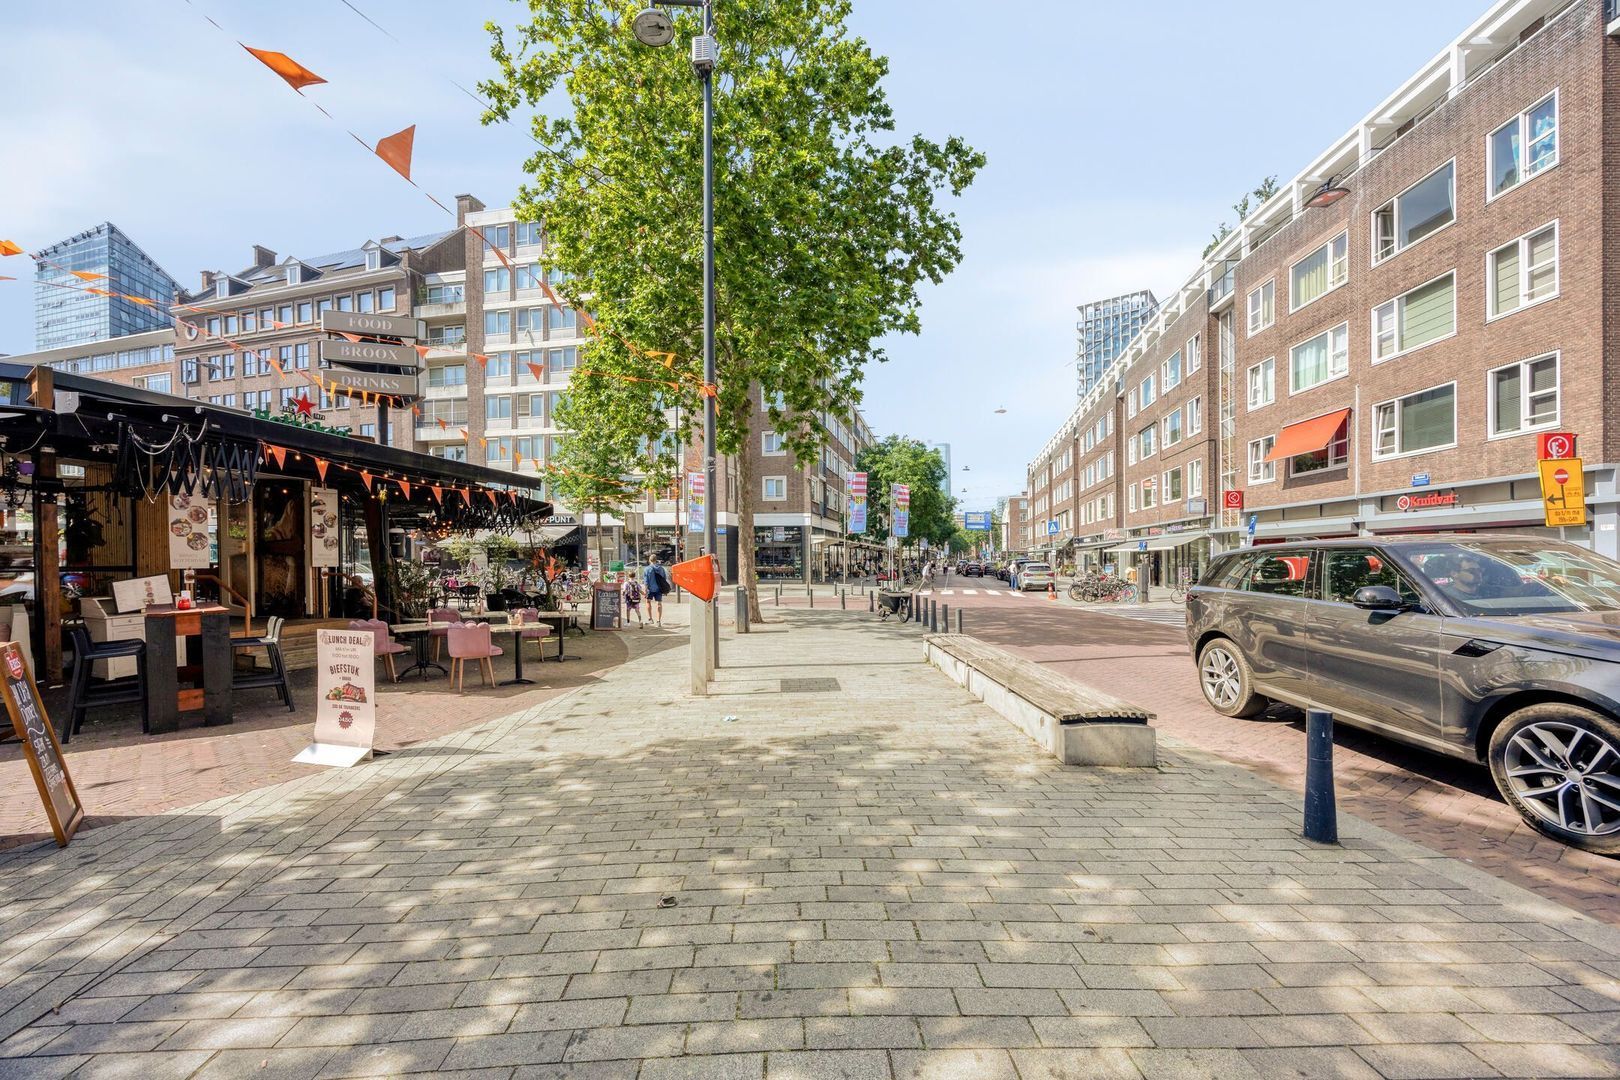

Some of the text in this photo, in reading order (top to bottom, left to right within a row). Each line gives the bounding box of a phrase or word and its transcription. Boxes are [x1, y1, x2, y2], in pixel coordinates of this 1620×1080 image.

[349, 317, 392, 330] FOOD
[340, 345, 398, 360] BROOX
[341, 375, 400, 389] DRINKS
[1410, 493, 1457, 507] Kruidvat
[328, 635, 363, 646] LUNCH DEAL
[329, 663, 360, 676] BIEFSTUK
